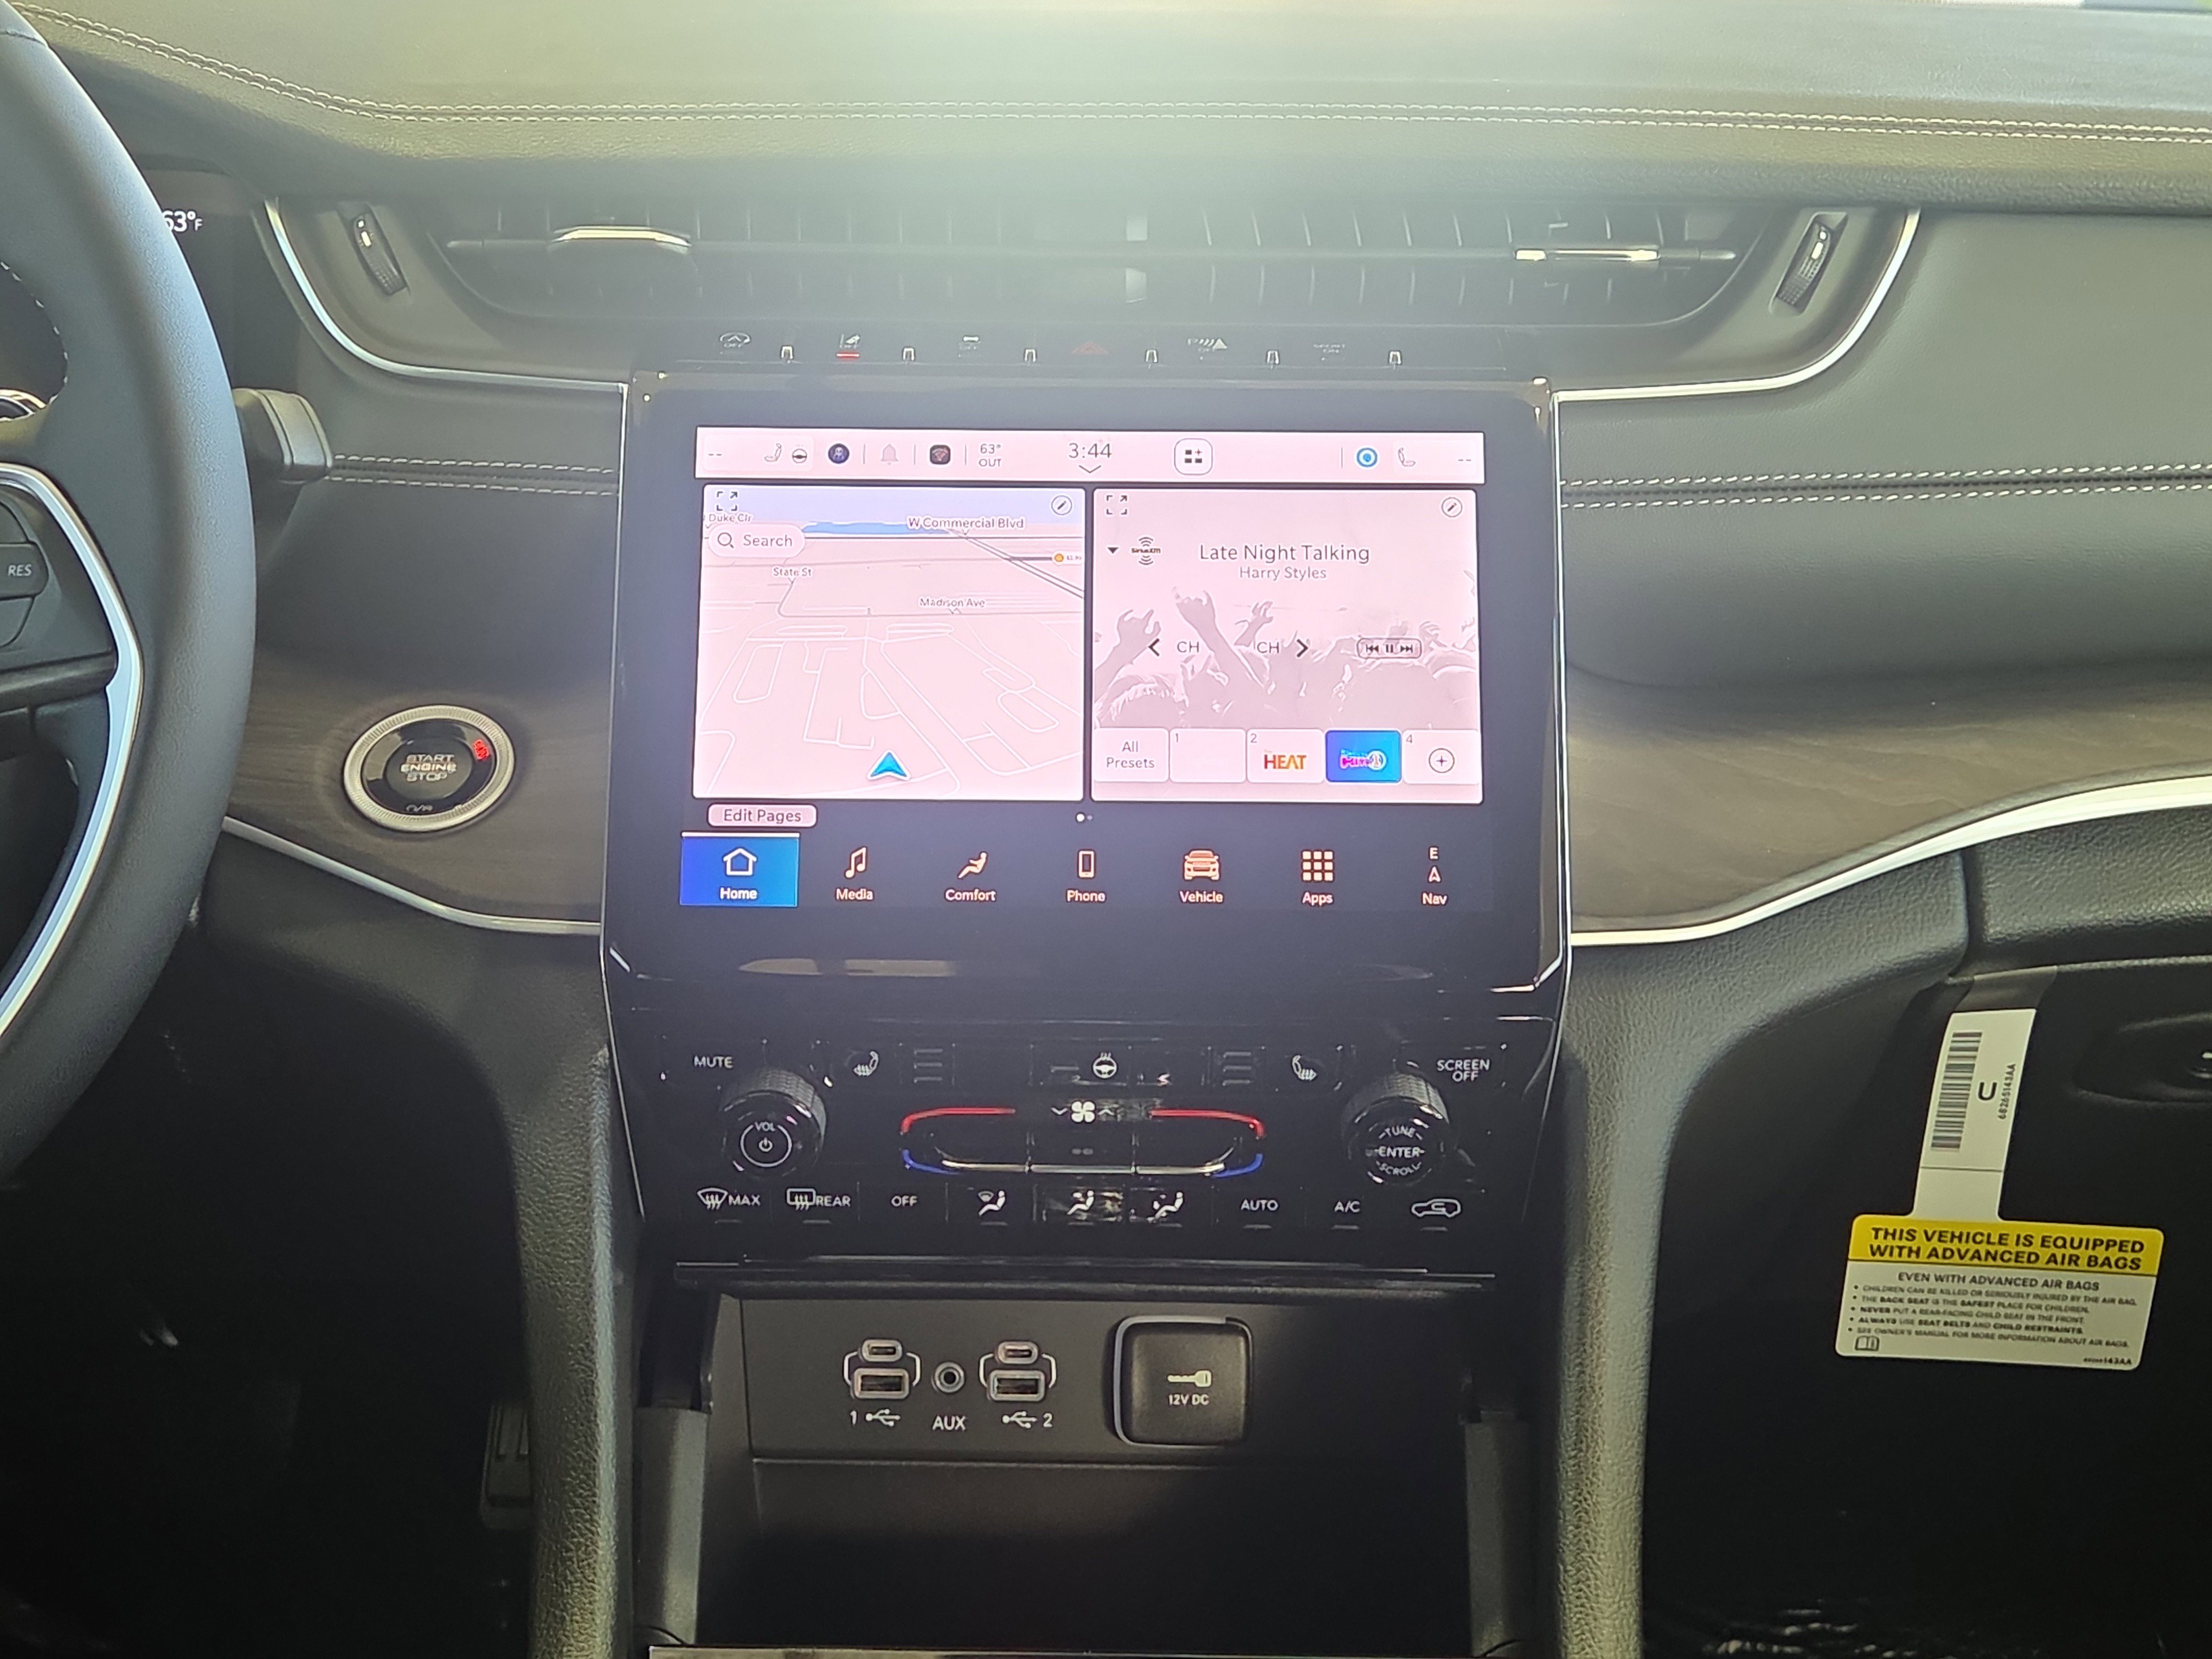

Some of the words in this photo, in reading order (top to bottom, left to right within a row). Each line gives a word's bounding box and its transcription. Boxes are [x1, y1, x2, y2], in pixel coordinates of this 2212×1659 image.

[1069, 442, 1112, 459] 3:44
[978, 459, 1002, 467] OUT
[908, 518, 920, 527] W
[923, 517, 994, 528] Commercial
[998, 518, 1024, 528] Blvd
[743, 535, 793, 547] Search
[1200, 544, 1237, 560] Late
[1244, 544, 1296, 563] Night
[1301, 544, 1369, 564] Talking
[8, 564, 32, 577] RES
[773, 567, 799, 576] State
[802, 567, 812, 576] St
[1240, 566, 1280, 581] Harry
[1284, 566, 1327, 581] Styles
[919, 598, 963, 607] Madison
[966, 599, 985, 607] Ave
[1176, 641, 1200, 654] CH
[1257, 641, 1280, 654] CH
[1250, 733, 1257, 743] 2
[1406, 734, 1413, 744] 4
[1122, 741, 1138, 753] All
[407, 754, 455, 763] START
[1107, 757, 1155, 768] Presets
[1264, 754, 1307, 769] HEAT
[401, 763, 456, 772] ENGINE
[407, 772, 447, 782] STOP
[723, 808, 753, 822] Edit
[757, 809, 801, 825] Pages
[1429, 847, 1439, 859] E
[720, 888, 757, 900] Home
[835, 888, 873, 901] Media
[945, 889, 996, 902] Comfort
[1066, 890, 1106, 903] Phone
[1180, 891, 1224, 904] Vehicle
[1302, 892, 1334, 906] Apps
[1422, 893, 1448, 905] Nav
[694, 1056, 733, 1068] MUTE
[1437, 1059, 1490, 1072] SCREEN
[1452, 1070, 1478, 1082] OFF
[1978, 1082, 1997, 1101] U
[755, 1122, 776, 1132] VOL
[1385, 1125, 1415, 1138] TUNE
[1379, 1146, 1420, 1158] ENTER
[1379, 1162, 1418, 1176] SCROLL
[728, 1194, 761, 1206] MAX
[816, 1194, 851, 1207] REAR
[891, 1195, 917, 1207] OFF
[1240, 1200, 1278, 1212] AUTO
[1334, 1200, 1360, 1214] A/C
[1872, 1227, 1918, 1242] THIS
[1923, 1229, 2010, 1246] VEHICLE
[2015, 1233, 2034, 1247] IS
[2040, 1235, 2145, 1253] EQUIPPED
[1869, 1244, 1921, 1259] WITH
[1926, 1247, 2040, 1264] ADVANCED
[2045, 1253, 2080, 1266] AIR
[2087, 1255, 2142, 1270] BAGS
[1898, 1272, 1930, 1282] EVEN
[1934, 1274, 1966, 1283] WITH
[1969, 1275, 2039, 1288] ADVANCED
[2041, 1279, 2063, 1289] AIR
[2066, 1280, 2100, 1290] BAGS
[1863, 1284, 1905, 1293] CHILDREN
[1985, 1289, 2030, 1299] SERIOUSLY
[1960, 1299, 1994, 1308] SAFEST
[1919, 1308, 1973, 1317] REAR-FACING
[1993, 1322, 2022, 1330] CHILD
[1997, 1333, 2056, 1343] INFORMATION
[1168, 1394, 1188, 1406] 12V
[1192, 1394, 1209, 1406] DC
[850, 1411, 857, 1424] 1
[933, 1416, 966, 1431] AUX
[1043, 1413, 1053, 1427] 2
